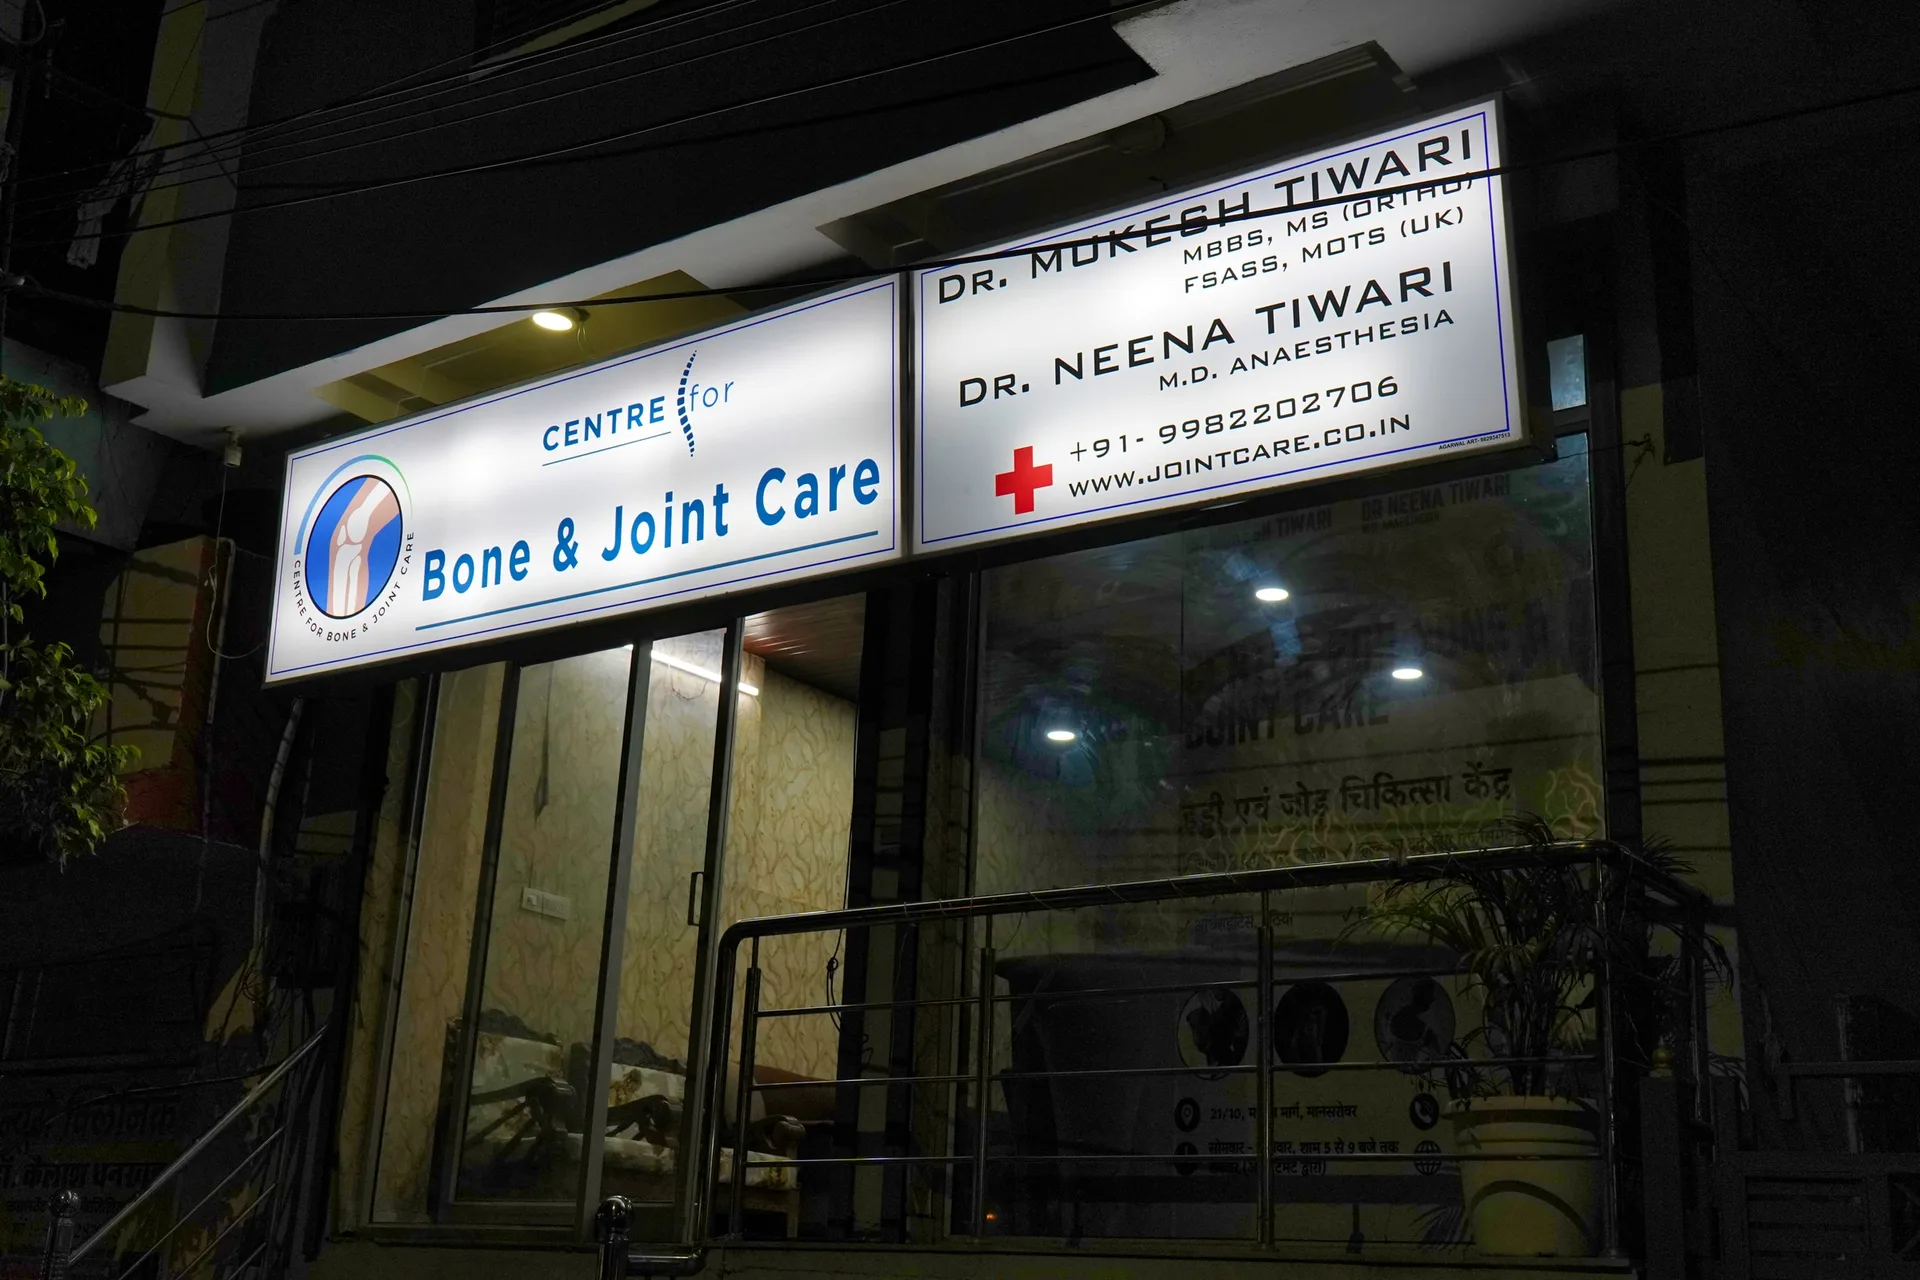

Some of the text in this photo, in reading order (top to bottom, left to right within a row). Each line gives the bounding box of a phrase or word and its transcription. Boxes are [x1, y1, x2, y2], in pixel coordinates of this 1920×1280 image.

[939, 129, 1471, 304] DR. MUKESH TIWARI
[1184, 229, 1273, 264] MBBS,
[1287, 211, 1329, 237] MS
[1185, 206, 1464, 293] FSASS, MOTS (UK)
[960, 261, 1453, 407] DR. NEENA TIWARI
[1159, 309, 1455, 391] M.D. ANAESTHESIA
[543, 381, 735, 452] CENTRE for
[1068, 414, 1412, 498] WWW.JOINTCARE.CO.IN
[1069, 375, 1400, 463] +91- 9982202706
[1439, 441, 1466, 450] AGARWAL
[422, 457, 881, 602] Bone & Joint Care
[293, 532, 415, 643] CENTRE FOR BONE & JOINT CARE
